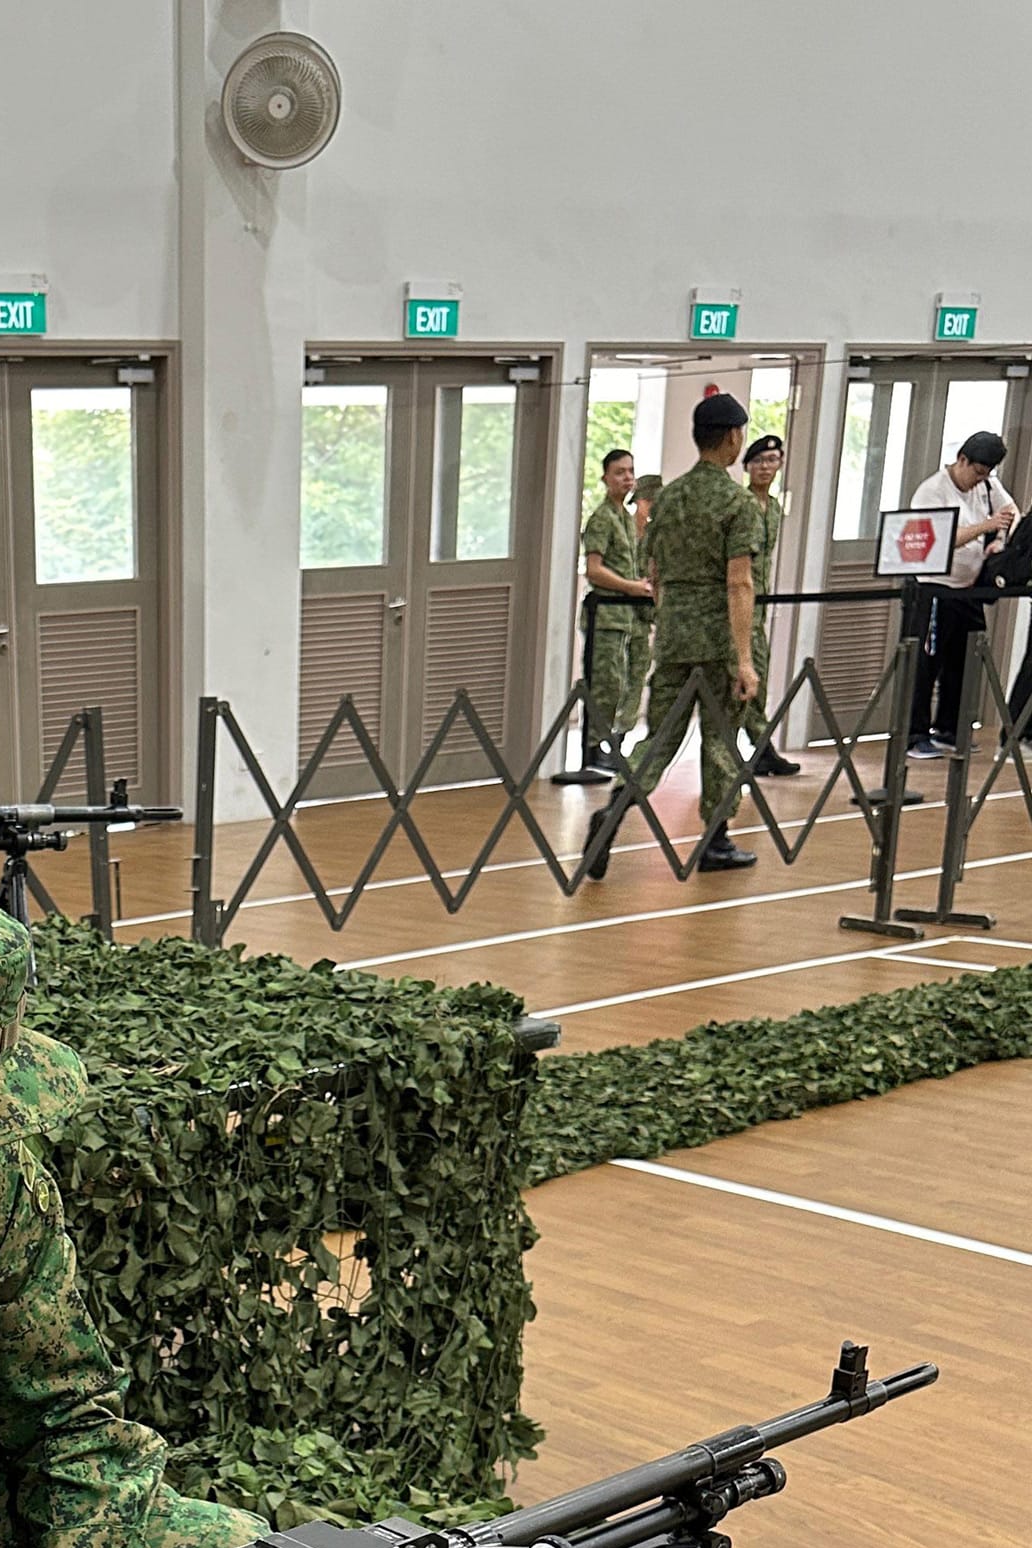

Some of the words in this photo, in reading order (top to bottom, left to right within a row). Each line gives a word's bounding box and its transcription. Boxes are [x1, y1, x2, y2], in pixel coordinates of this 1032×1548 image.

[416, 306, 450, 332] EXIT
[699, 310, 730, 334] EXIT
[943, 313, 970, 335] EXIT
